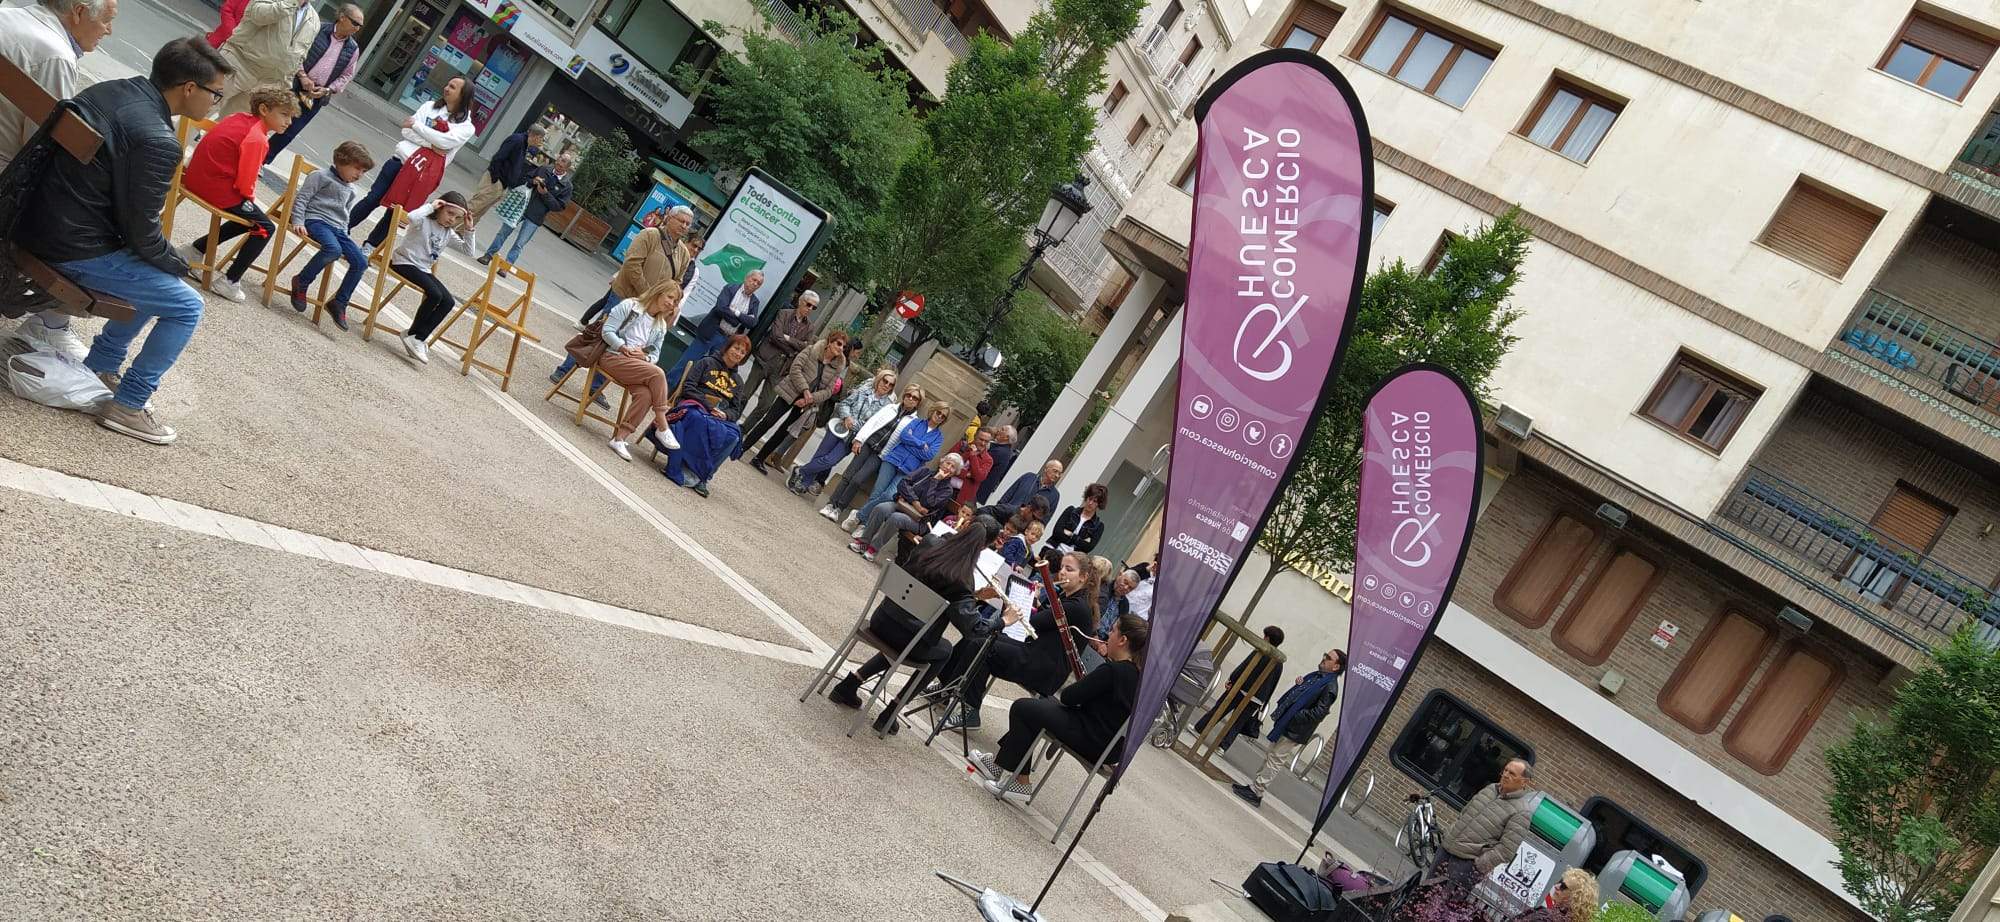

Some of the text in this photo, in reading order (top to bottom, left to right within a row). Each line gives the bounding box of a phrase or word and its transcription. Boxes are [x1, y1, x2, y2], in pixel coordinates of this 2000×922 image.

[740, 195, 780, 225] el cáncer
[747, 184, 773, 208] Todos
[771, 200, 801, 228] contra
[1497, 873, 1529, 898] RESTO
